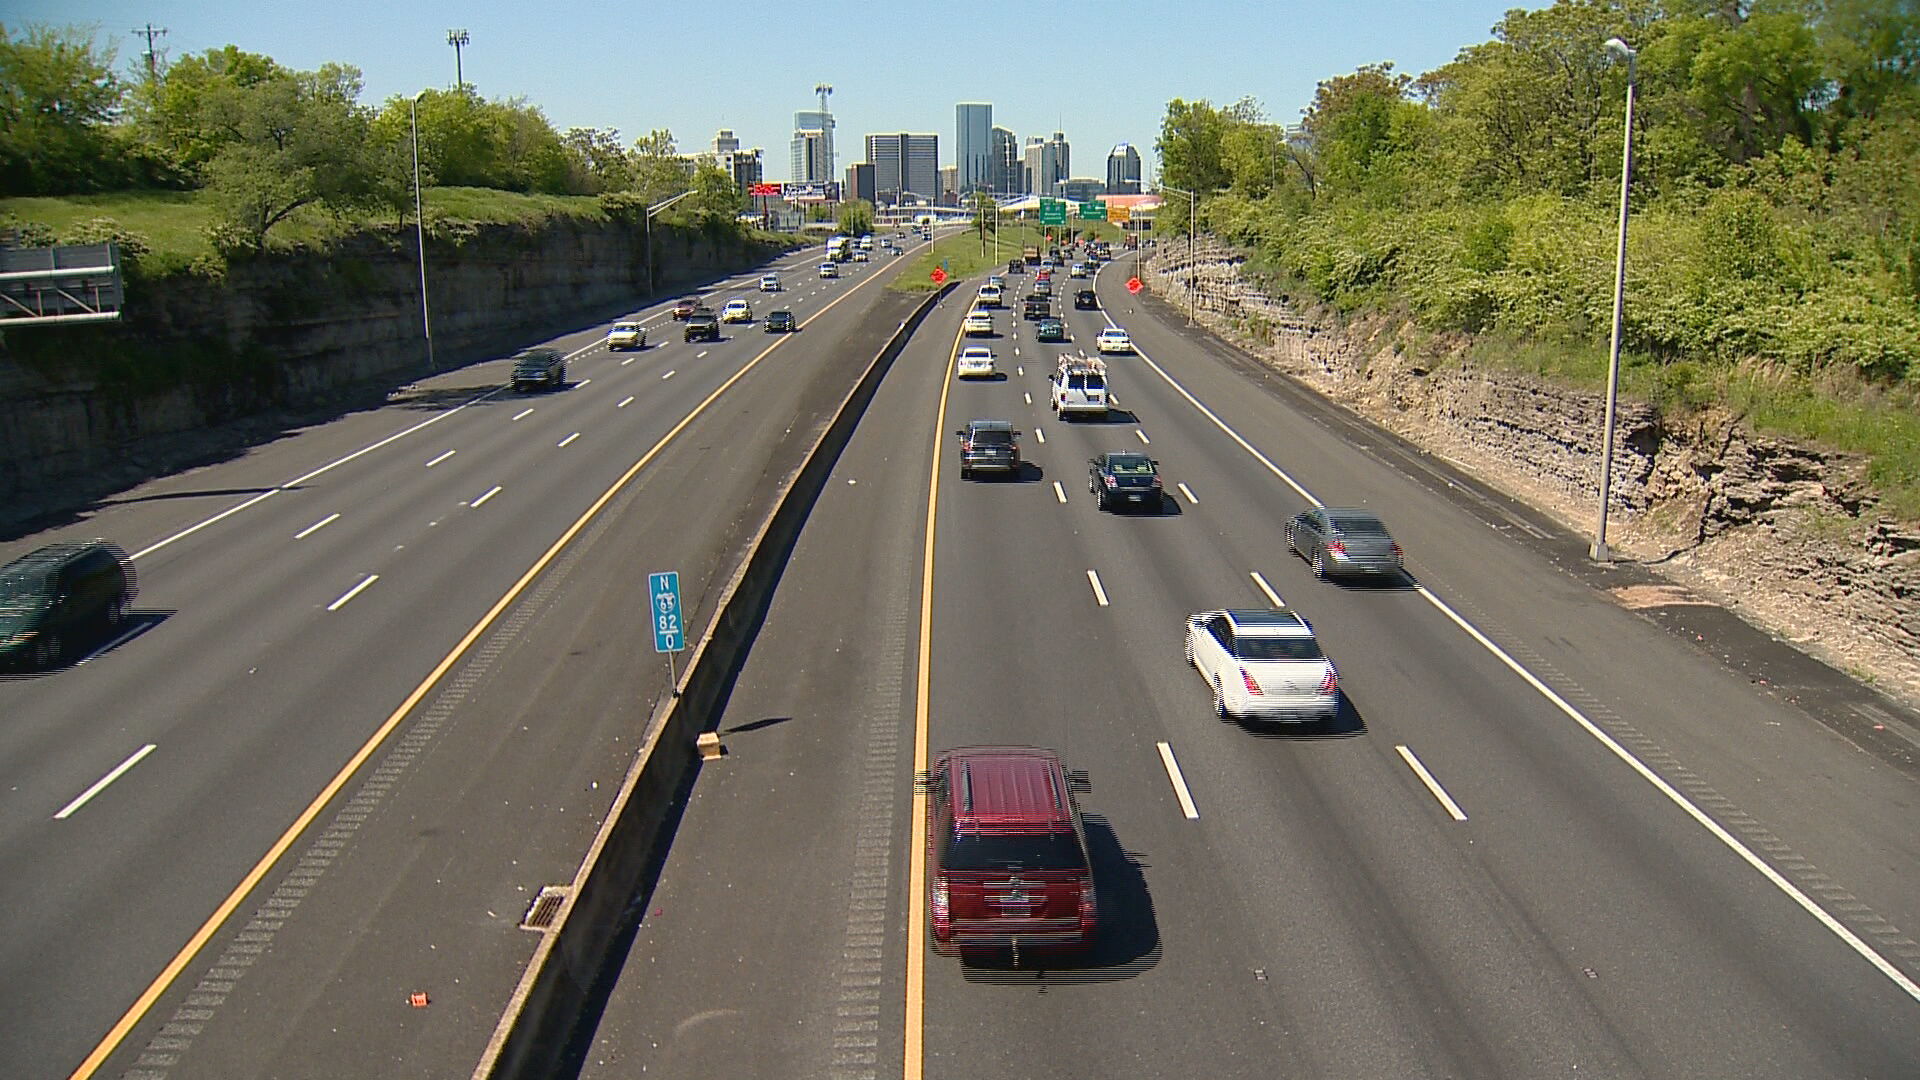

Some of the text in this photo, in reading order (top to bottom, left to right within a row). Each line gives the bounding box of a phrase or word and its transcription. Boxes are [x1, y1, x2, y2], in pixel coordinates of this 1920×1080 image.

[660, 576, 669, 591] N
[660, 598, 673, 610] 65
[659, 615, 677, 630] 82
[666, 635, 674, 649] 0
